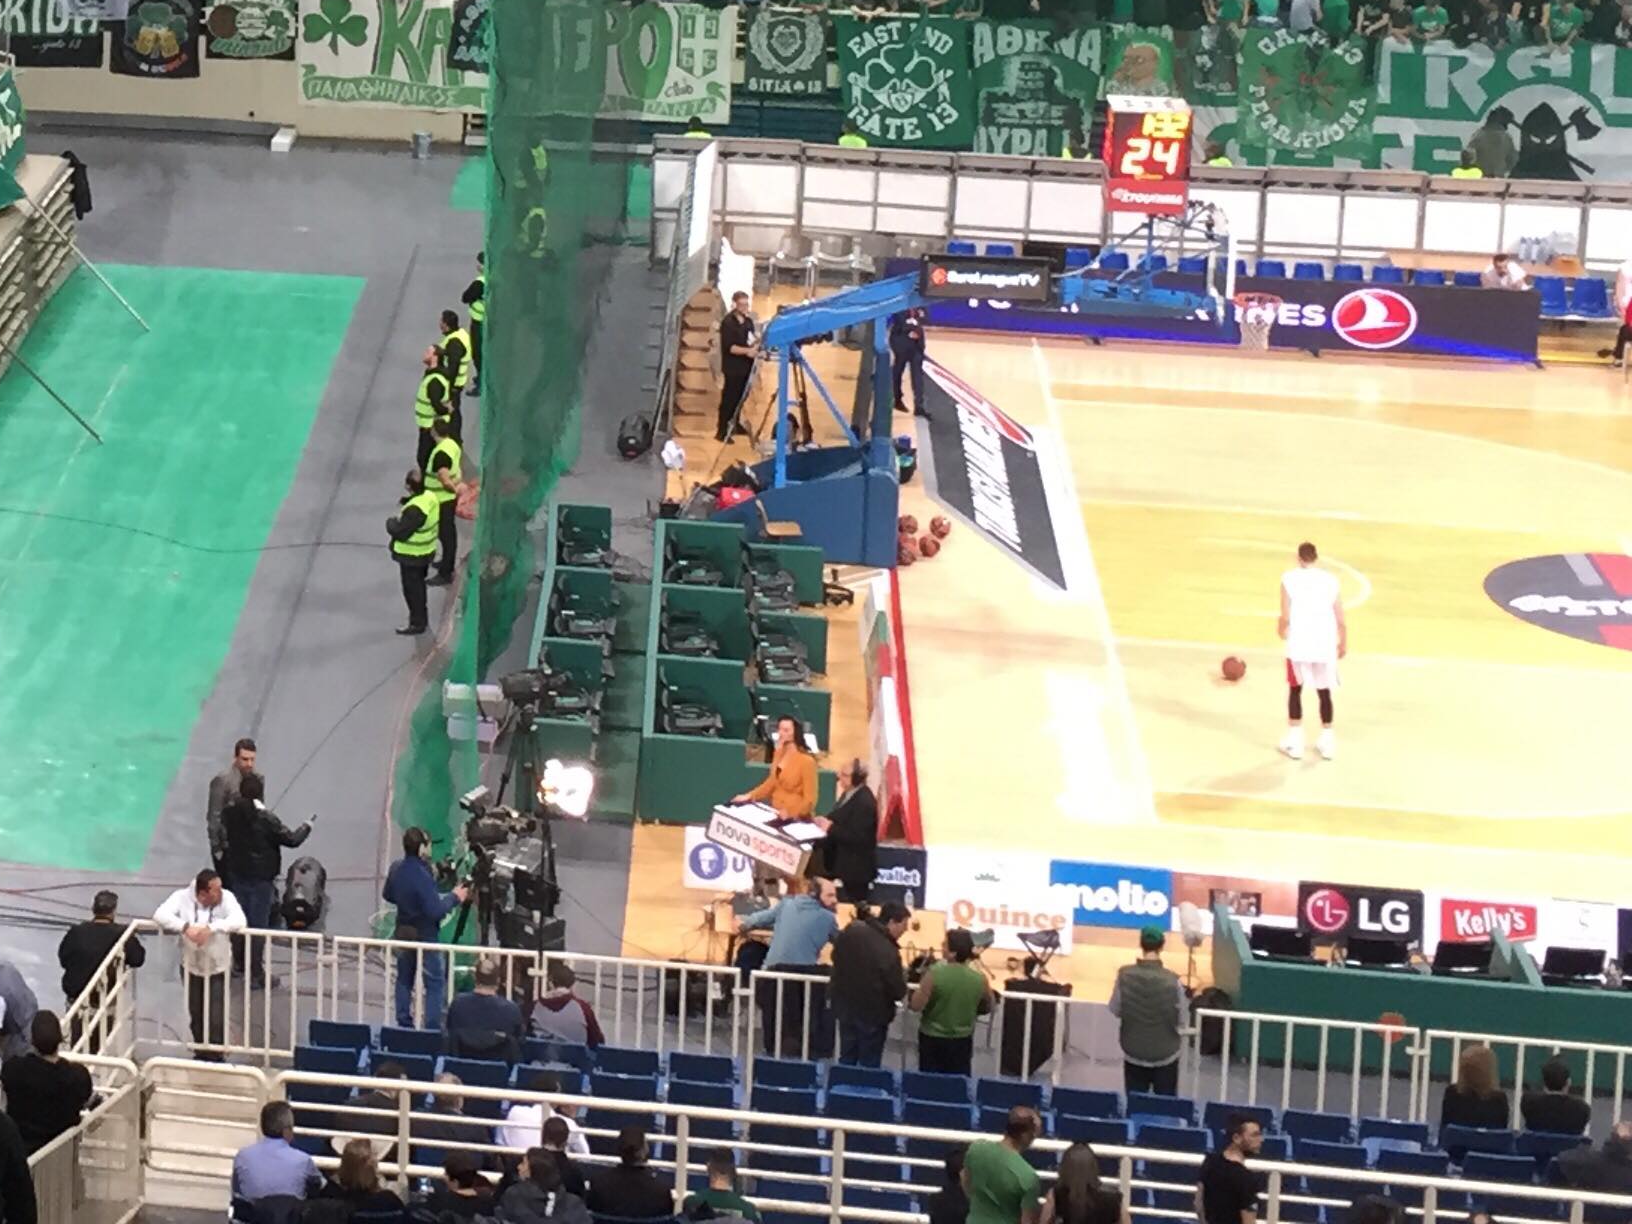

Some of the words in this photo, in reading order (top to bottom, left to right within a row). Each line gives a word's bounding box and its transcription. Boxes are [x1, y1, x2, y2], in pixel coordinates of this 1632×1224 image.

[847, 21, 903, 59] EAST
[910, 23, 955, 56] ND
[926, 102, 960, 132] 13
[1120, 136, 1181, 176] 24
[951, 896, 1066, 933] Quince
[1357, 899, 1411, 934] LG
[1452, 907, 1528, 939] Kelly's
